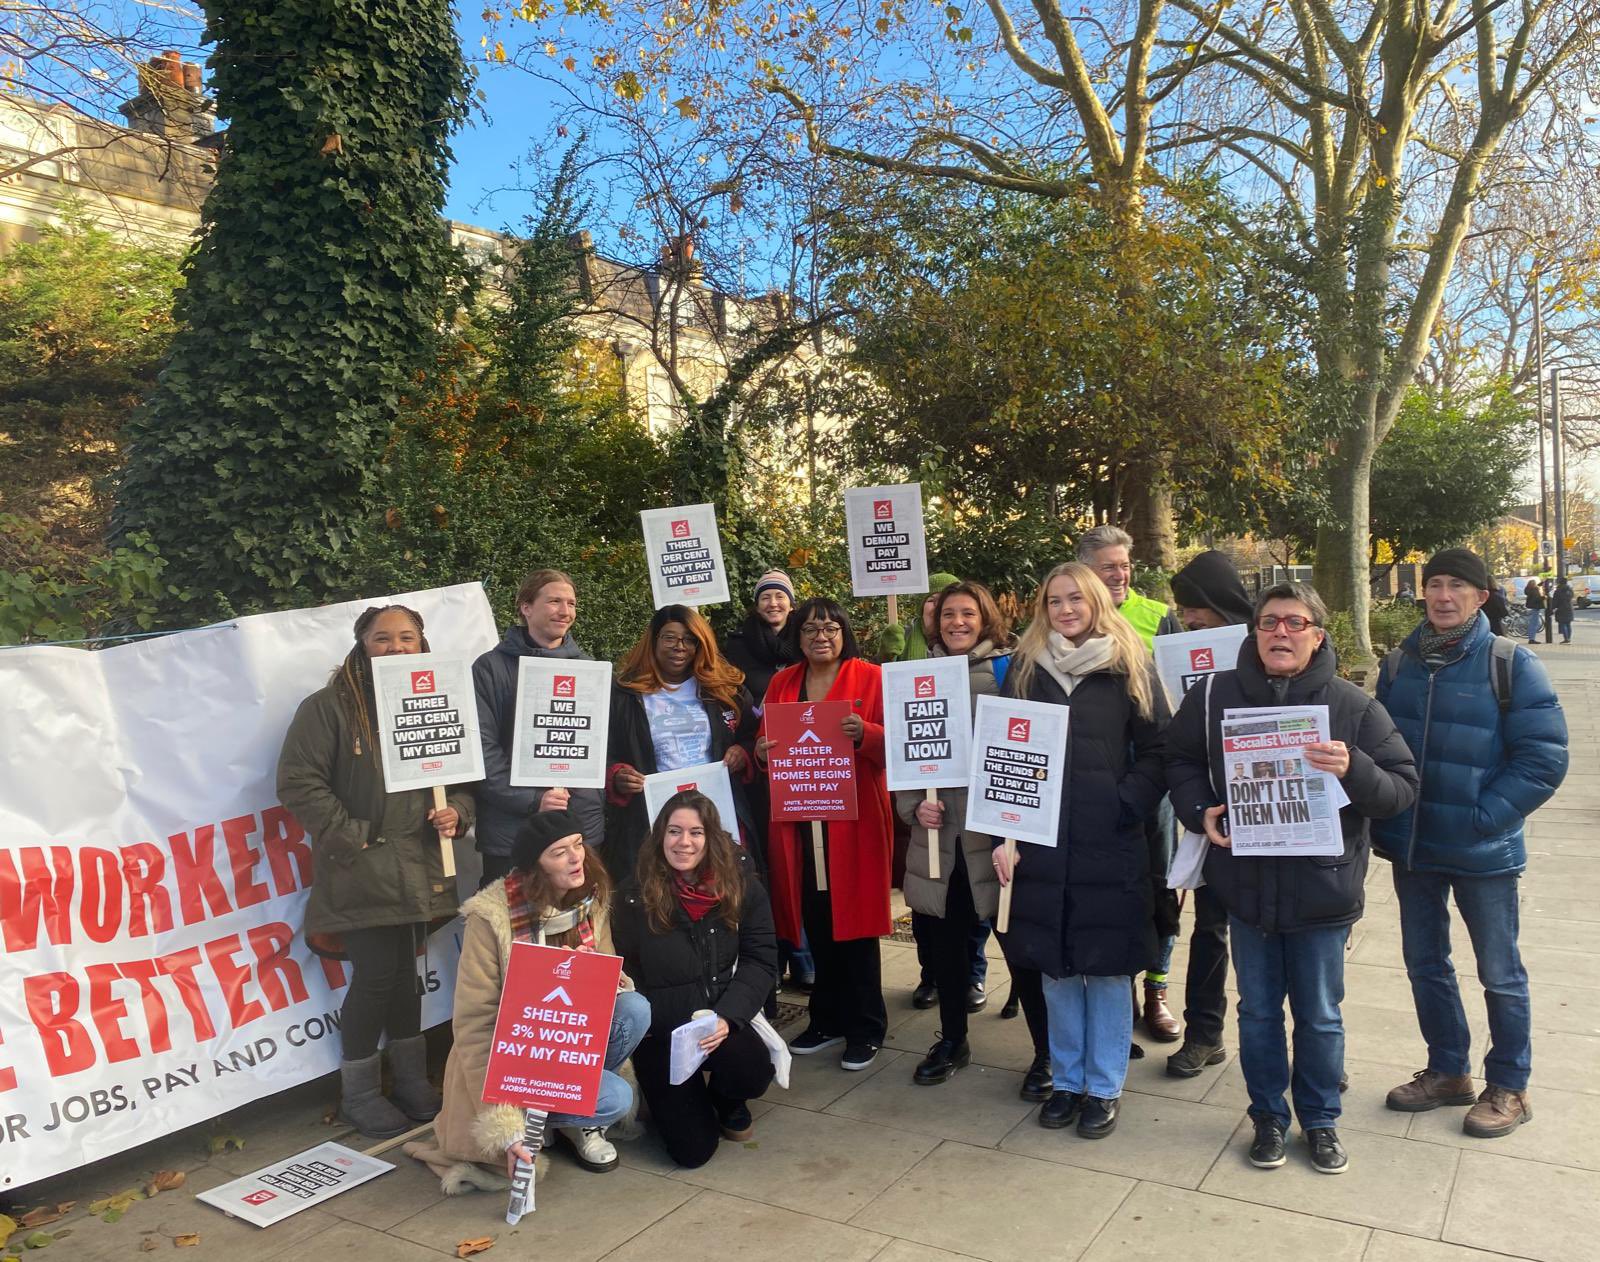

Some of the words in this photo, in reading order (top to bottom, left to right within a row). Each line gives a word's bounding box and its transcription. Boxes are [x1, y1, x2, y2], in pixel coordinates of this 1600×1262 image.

[876, 523, 894, 532] WE
[668, 540, 699, 550] THREE
[865, 535, 907, 546] DEMAND
[663, 553, 682, 563] PER
[683, 549, 708, 560] CENT
[877, 548, 896, 558] PAY
[662, 563, 693, 575] WON'T
[694, 560, 713, 570] PAY
[868, 560, 908, 571] JUSTICE
[669, 576, 684, 586] MY
[685, 572, 710, 583] RENT
[405, 697, 445, 711] THREE
[553, 701, 574, 712] WE
[908, 701, 944, 718] FAIR
[397, 713, 422, 727] PER
[424, 711, 457, 725] CENT
[537, 717, 588, 729] DEMAND
[394, 728, 437, 743] WON'T
[439, 725, 462, 739] PAY
[550, 731, 573, 742] PAY
[912, 721, 943, 738] PAY
[1279, 731, 1319, 745] Worker
[403, 746, 422, 758] MY
[426, 742, 458, 756] RENT
[536, 746, 585, 758] JUSTICE
[789, 746, 833, 756] SHELTER
[908, 742, 949, 759] NOW
[988, 748, 1026, 762] SHELTER
[1027, 754, 1046, 764] HAS
[772, 759, 792, 767] THE
[796, 758, 826, 767] FIGHT
[829, 757, 850, 766] FOR
[986, 762, 1003, 771] THE
[1004, 764, 1034, 777] FUNDS
[772, 771, 810, 780] HOMES
[813, 770, 851, 779] BEGINS
[790, 783, 817, 792] WITH
[820, 783, 839, 791] PAY
[992, 776, 1004, 786] TO
[1006, 779, 1023, 789] PAY
[1024, 782, 1036, 791] US
[988, 790, 994, 798] A
[995, 792, 1014, 802] FAIR
[1016, 795, 1038, 806] RATE
[1230, 780, 1274, 804] DON'T
[1279, 779, 1305, 801] LET
[1232, 803, 1274, 826] THEM
[1277, 800, 1310, 824] WIN
[23, 921, 310, 1077] BETTER
[522, 1006, 588, 1028] SHELTER
[511, 1023, 534, 1040] 3%
[540, 1027, 593, 1047] WON'T
[496, 1041, 526, 1057] PAY
[530, 1044, 555, 1062] MY
[559, 1049, 600, 1067] RENT
[43, 1085, 137, 1131] JOBS,
[142, 1063, 200, 1100] PAY
[213, 1037, 278, 1077] AND
[529, 1079, 564, 1090] FIGHTING
[566, 1084, 582, 1093] FOR
[500, 1084, 582, 1101] #JOBSPAYCONDITIONS
